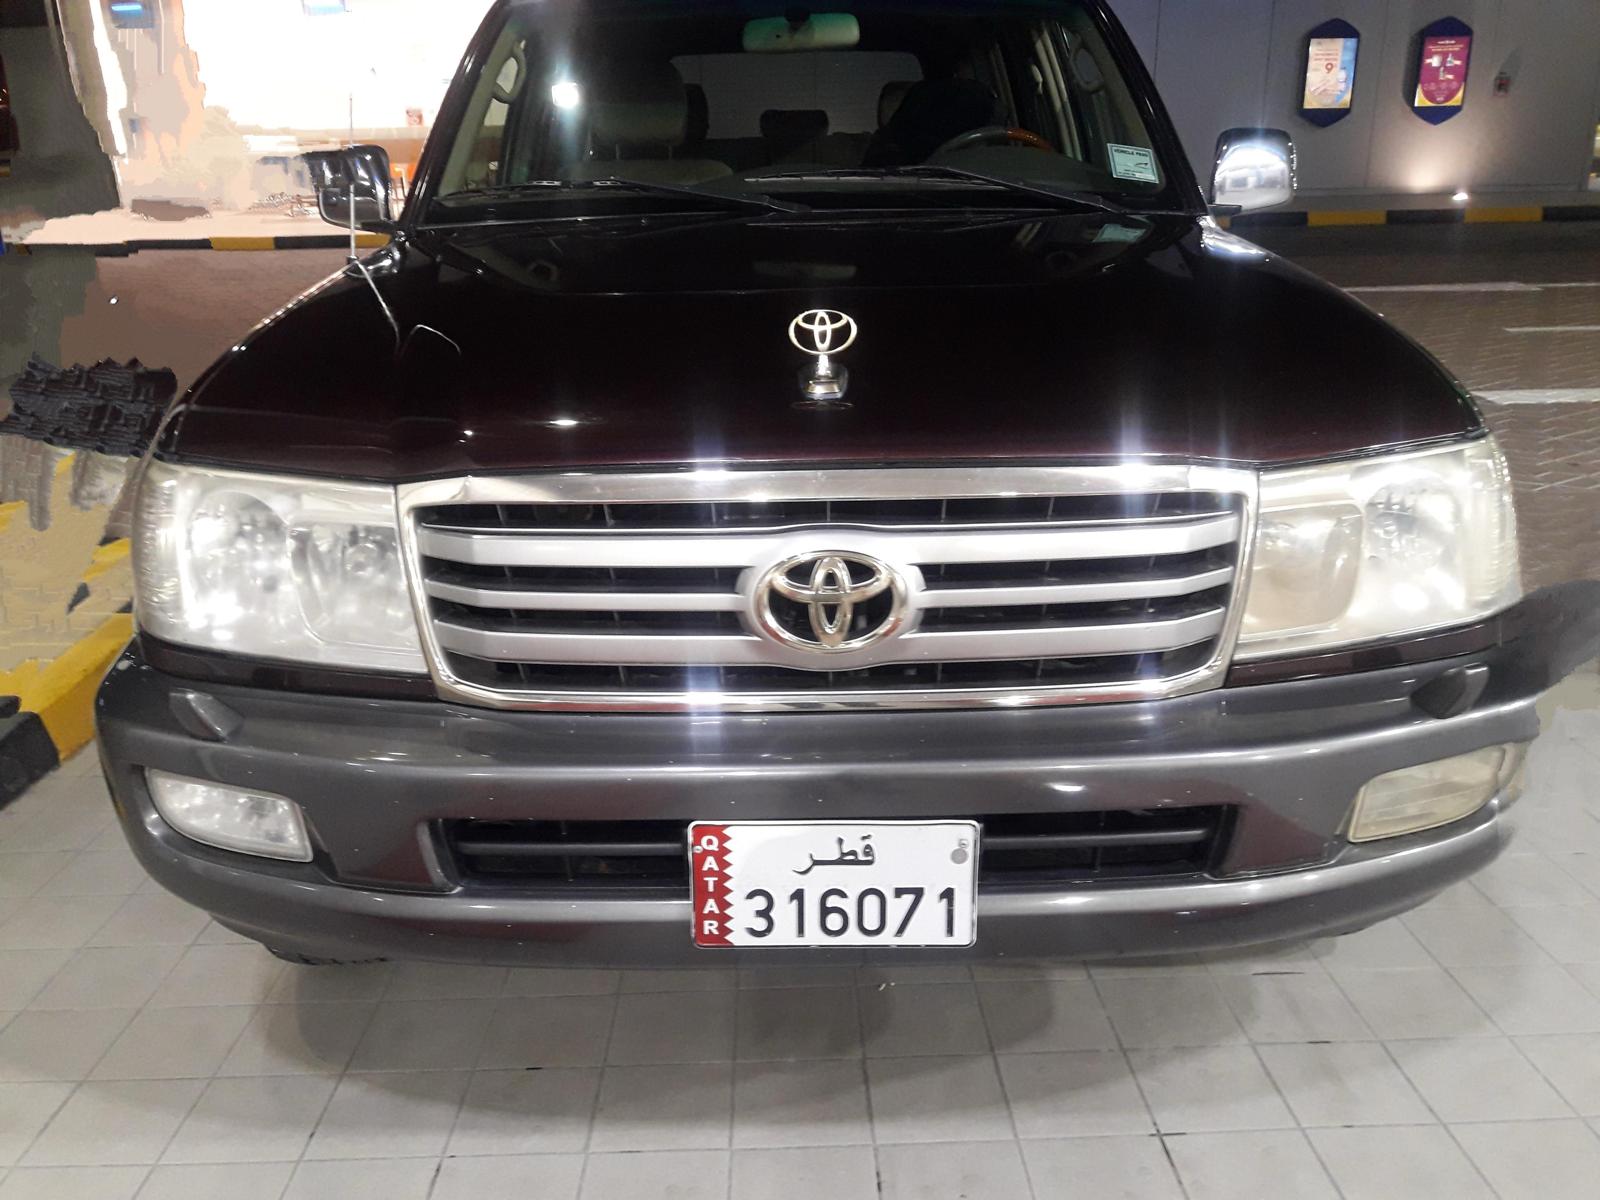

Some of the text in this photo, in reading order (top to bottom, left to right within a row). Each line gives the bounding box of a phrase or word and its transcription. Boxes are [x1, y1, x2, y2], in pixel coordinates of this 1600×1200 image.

[792, 834, 875, 875] قطر
[700, 835, 720, 935] QATAR
[745, 886, 956, 938] 316071
